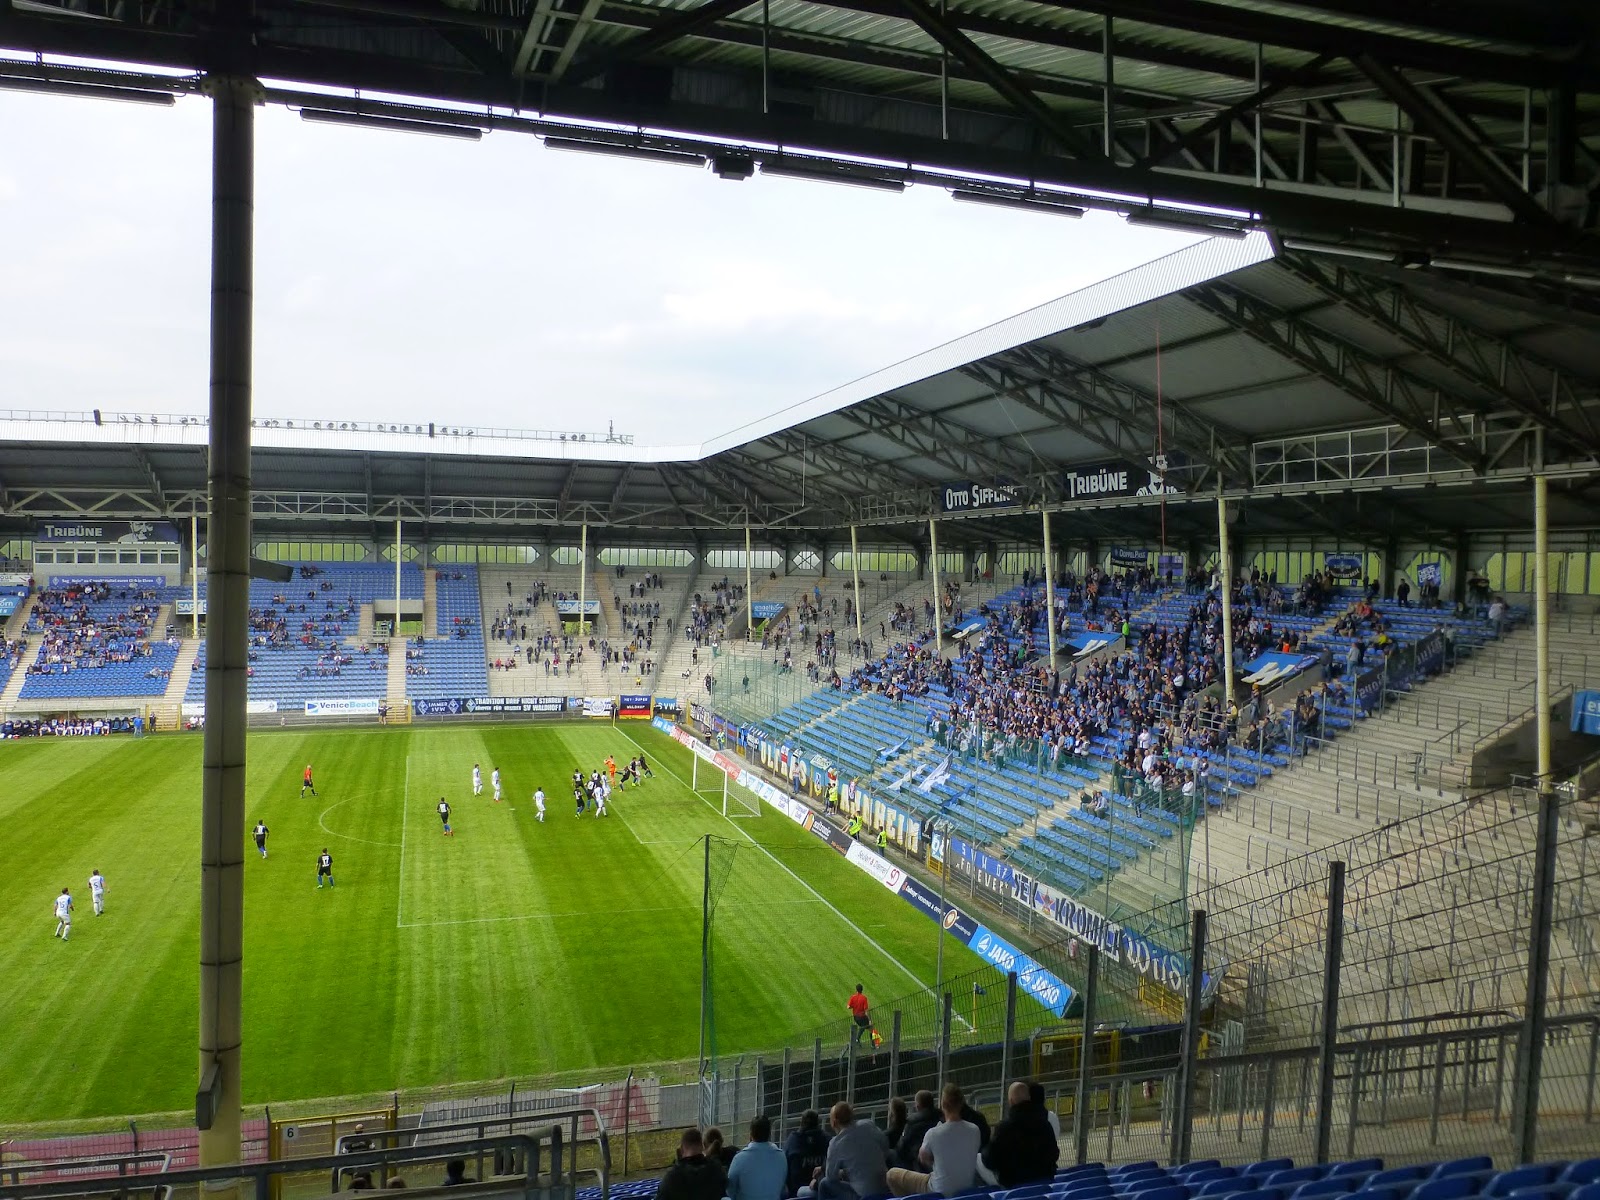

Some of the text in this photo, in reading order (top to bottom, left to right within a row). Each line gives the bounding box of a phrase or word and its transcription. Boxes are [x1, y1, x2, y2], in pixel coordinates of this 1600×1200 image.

[1067, 468, 1128, 498] TRIBÜNE
[946, 488, 969, 509] OTTO
[44, 522, 103, 538] TRIBÜNE
[558, 603, 573, 611] SAP
[987, 944, 1016, 970] JAKO
[1031, 976, 1061, 1005] JAKO
[286, 1127, 294, 1139] 6
